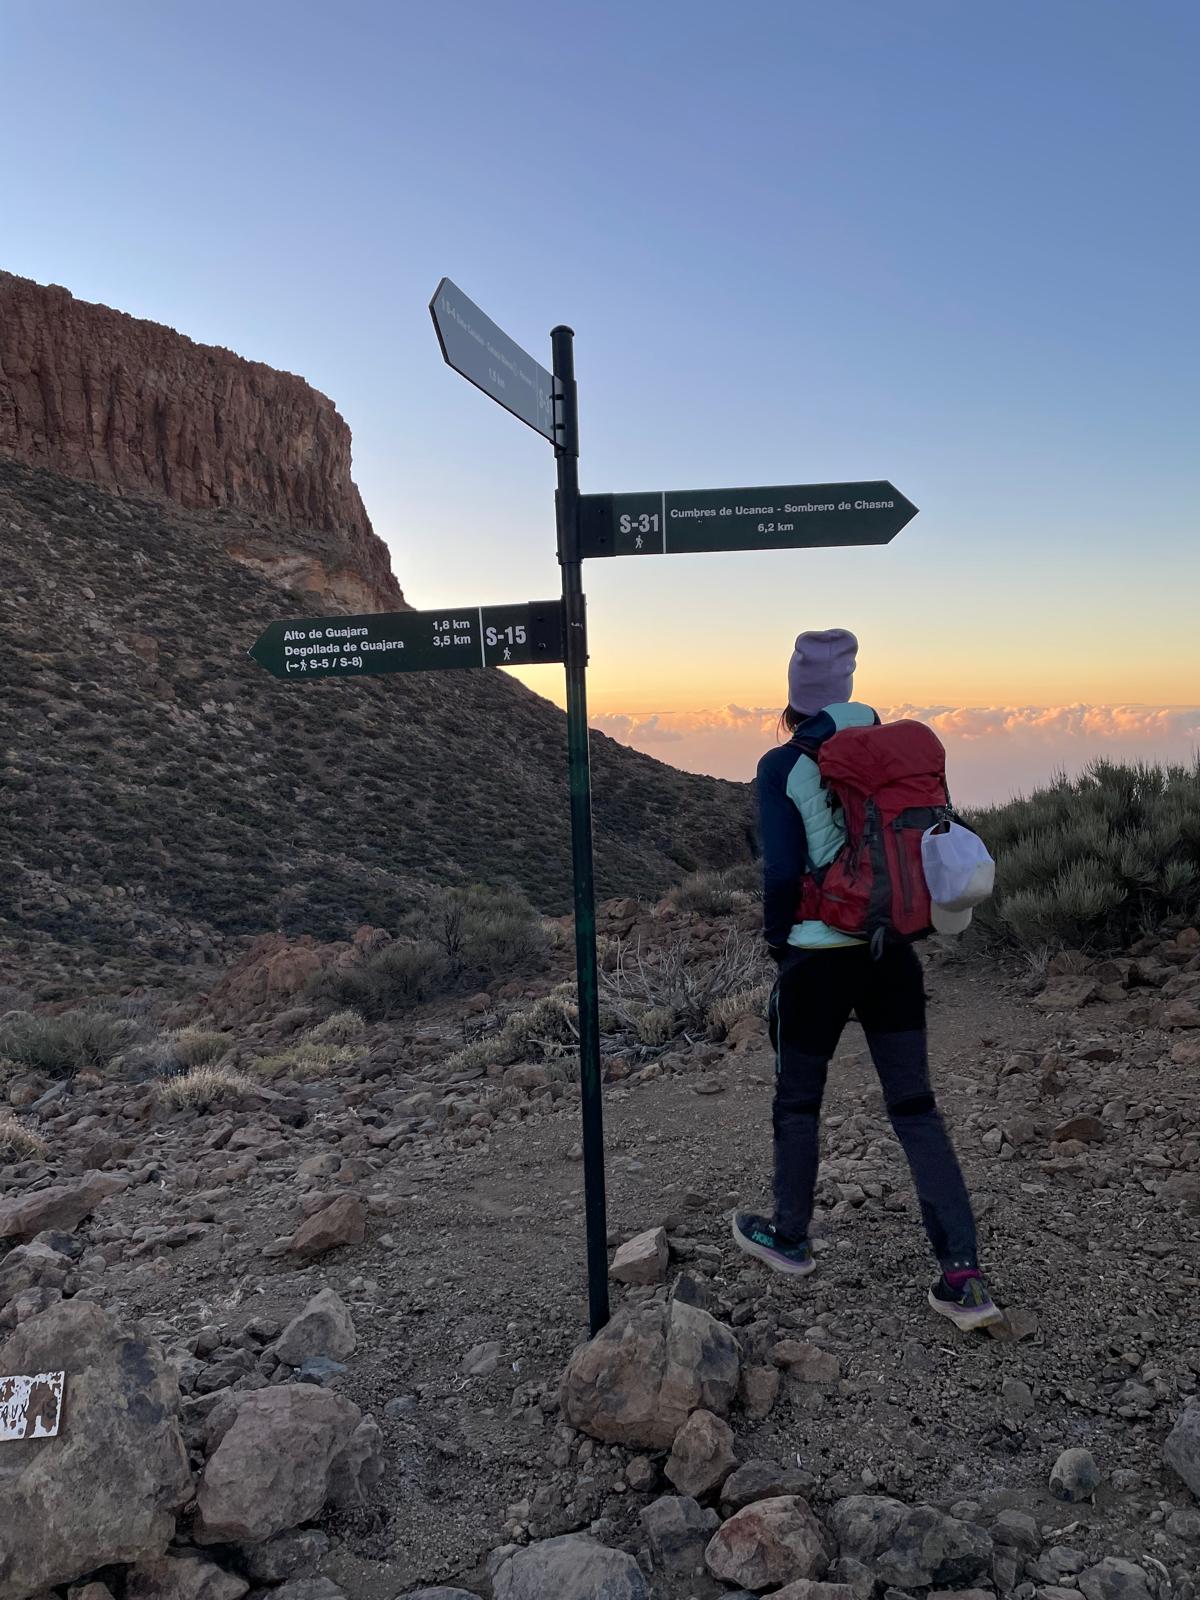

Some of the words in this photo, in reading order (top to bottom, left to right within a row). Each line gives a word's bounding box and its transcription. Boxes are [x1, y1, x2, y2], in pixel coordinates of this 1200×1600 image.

[670, 508, 716, 518] Cumbres
[719, 506, 732, 516] de
[735, 506, 774, 515] Ucanca
[784, 503, 835, 513] Sombrero
[838, 501, 851, 510] de
[854, 500, 894, 510] Chasna
[619, 514, 659, 533] S-31
[757, 523, 775, 533] 6,2
[777, 522, 794, 531] km
[283, 630, 306, 641] Alto
[308, 629, 323, 639] de
[325, 627, 368, 638] Guajara
[432, 620, 450, 631] 1,8
[452, 619, 470, 629] km
[485, 625, 527, 646] S-15
[284, 644, 340, 656] Degollada
[343, 642, 357, 652] de
[360, 639, 404, 651] Guajara
[432, 635, 451, 647] 3,5
[453, 634, 471, 645] km
[339, 656, 363, 668] S-8)
